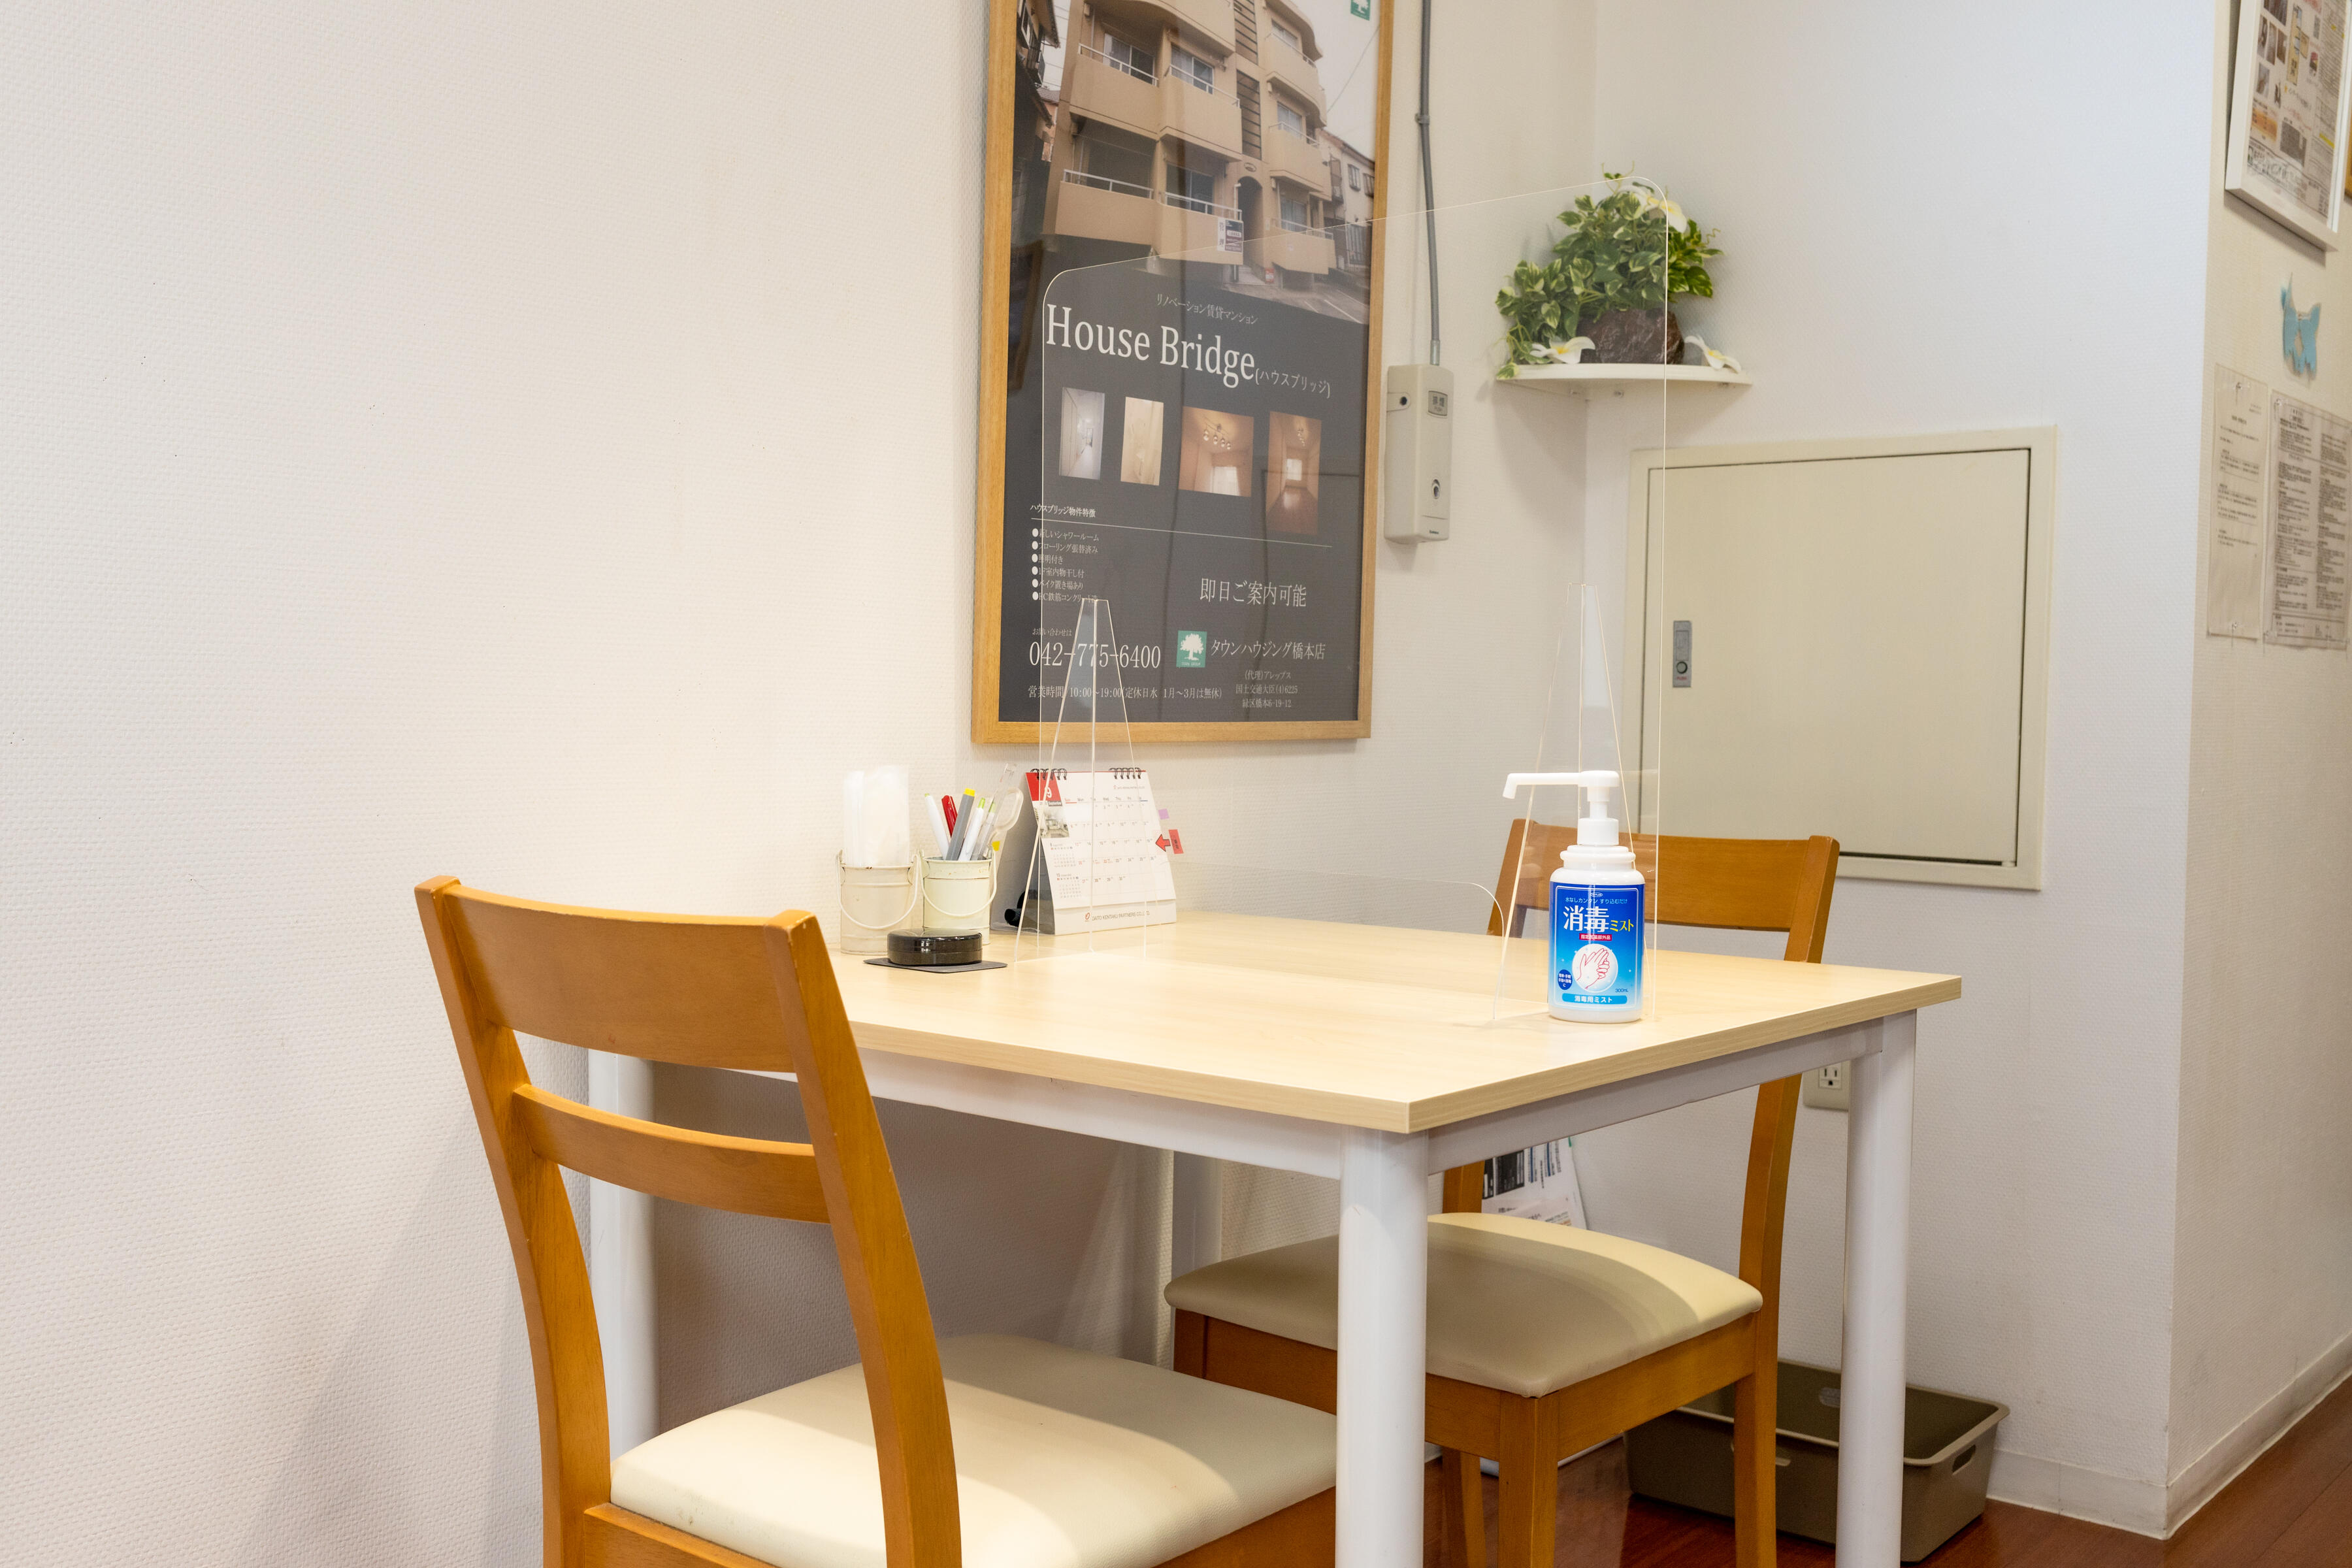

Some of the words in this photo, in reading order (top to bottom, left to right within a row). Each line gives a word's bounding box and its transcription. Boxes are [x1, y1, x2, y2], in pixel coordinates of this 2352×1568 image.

[1157, 293, 1258, 325] リノベーション賃貸マンション
[1046, 303, 1151, 361] House
[1160, 325, 1255, 388] Bridge
[1200, 578, 1307, 607] 即日ご案内可能
[1029, 642, 1161, 668] 042-775-6400
[1211, 639, 1326, 660] タウンハウジング橋本店
[1563, 905, 1634, 932] 消毒ミスト
[1574, 995, 1612, 1004] 消毒用ミスト
